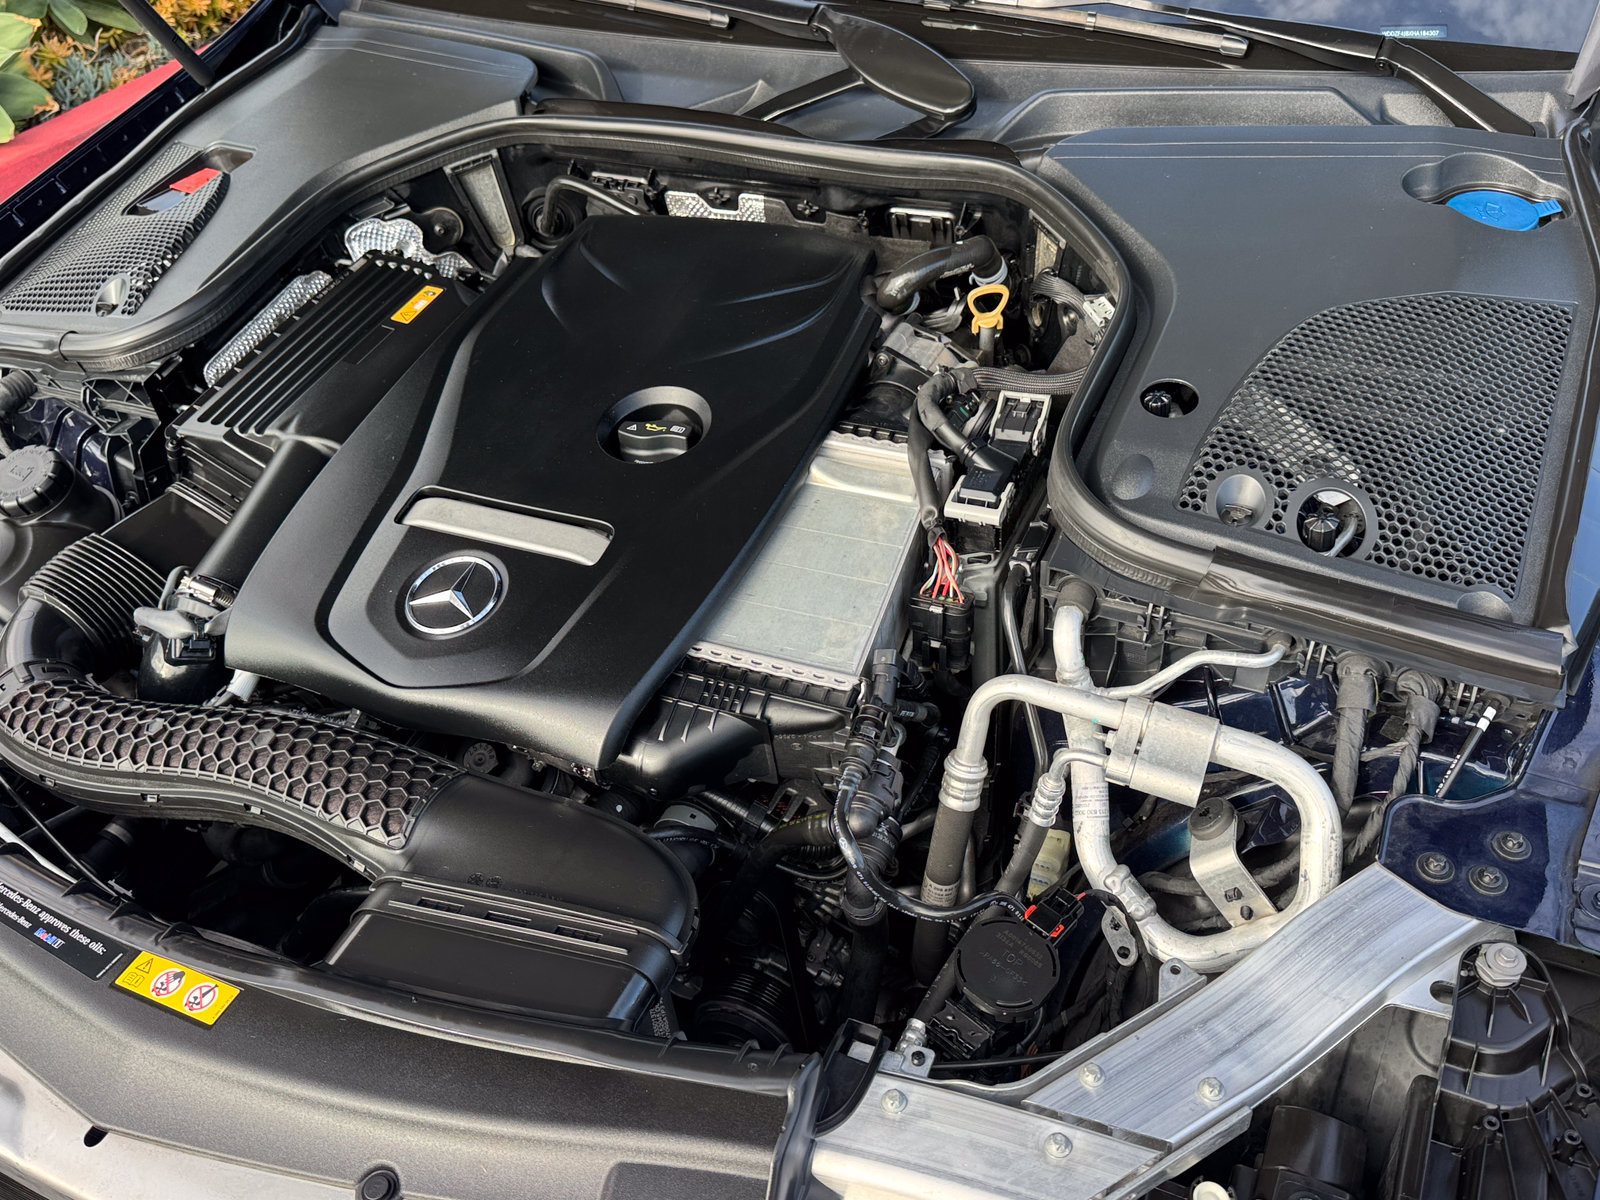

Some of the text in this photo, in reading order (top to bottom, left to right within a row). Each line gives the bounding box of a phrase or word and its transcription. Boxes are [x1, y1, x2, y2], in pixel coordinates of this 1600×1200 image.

[38, 910, 72, 933] approves
[68, 928, 91, 946] these
[88, 942, 107, 955] oils:
[1002, 950, 1024, 966] TOP
